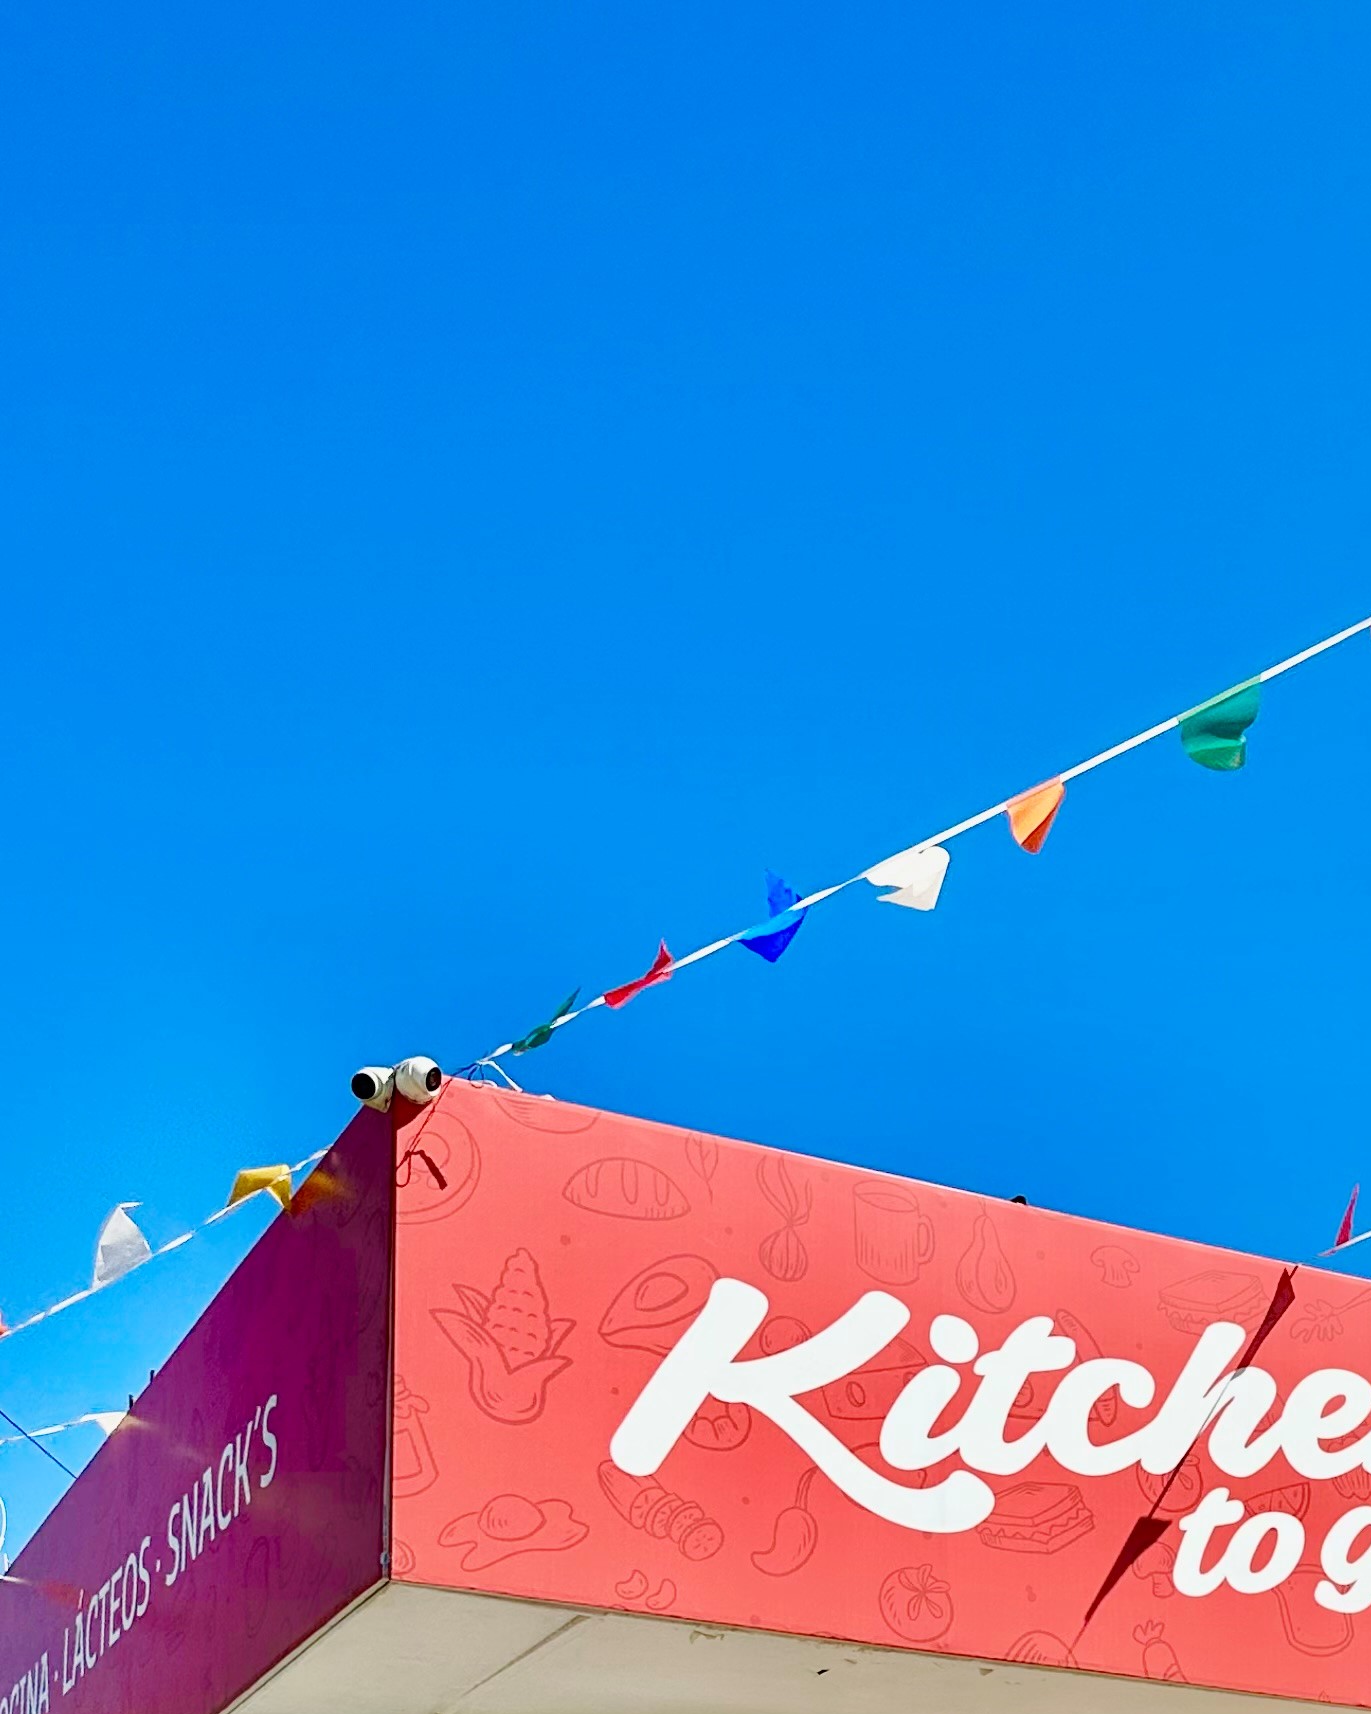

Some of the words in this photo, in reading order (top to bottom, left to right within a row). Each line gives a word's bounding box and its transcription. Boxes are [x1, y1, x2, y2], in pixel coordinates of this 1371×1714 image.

[63, 1536, 151, 1696] LÁCTEOS
[166, 1395, 277, 1587] SNACK'S
[1174, 1487, 1305, 1597] to
